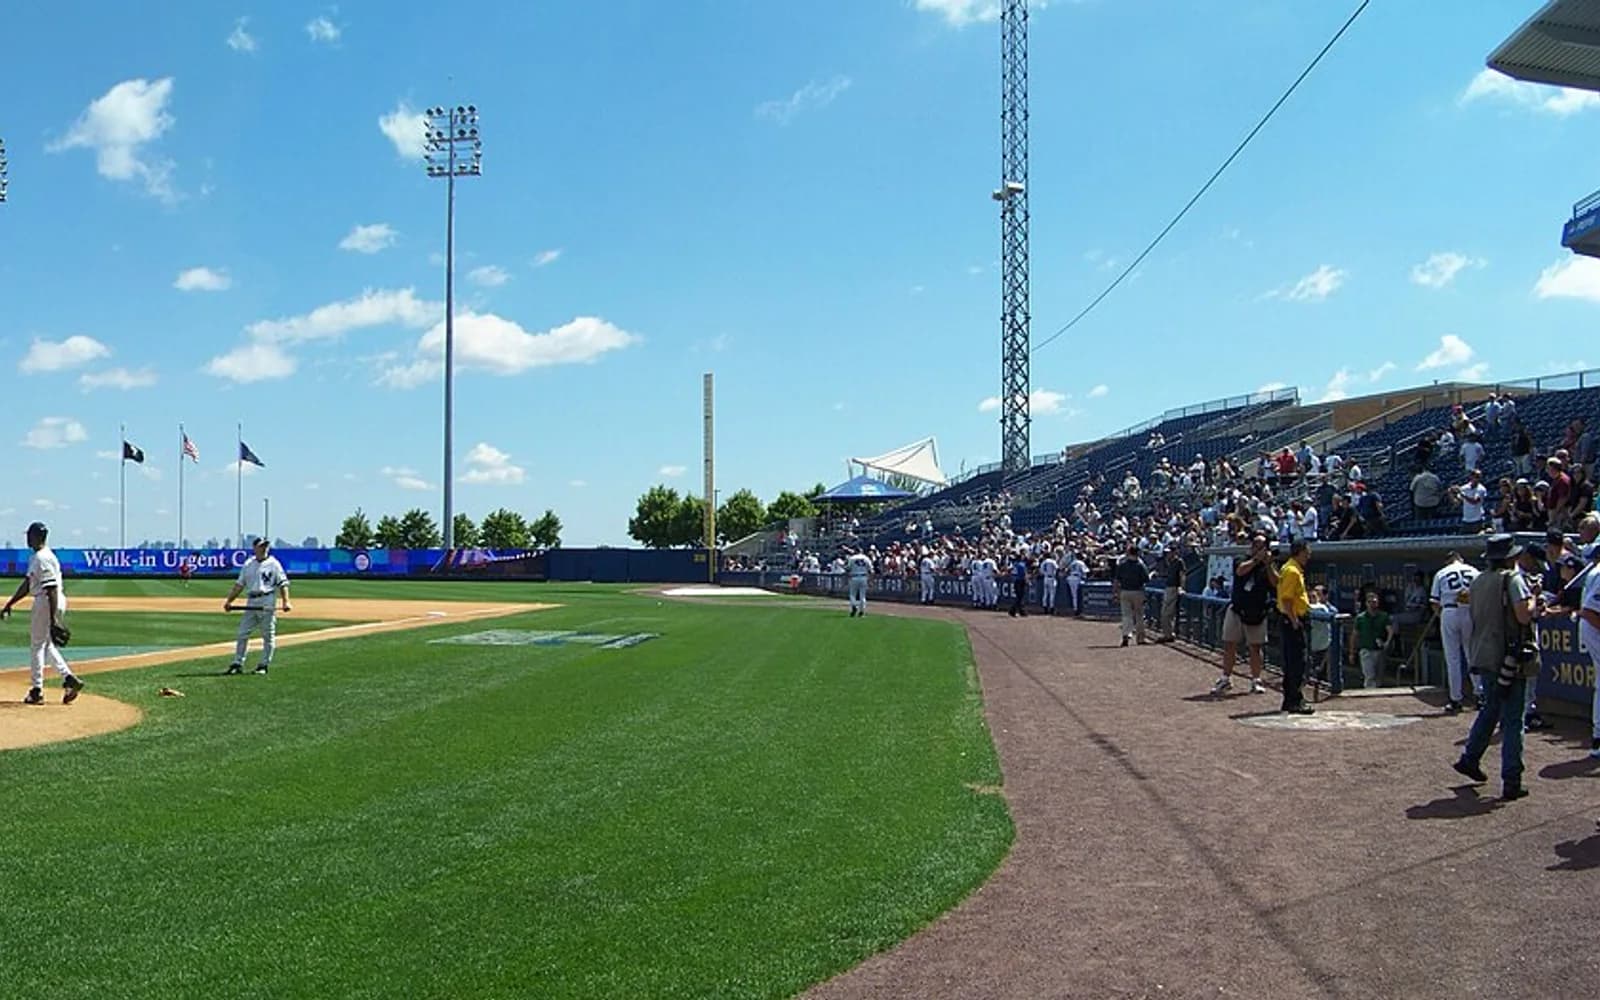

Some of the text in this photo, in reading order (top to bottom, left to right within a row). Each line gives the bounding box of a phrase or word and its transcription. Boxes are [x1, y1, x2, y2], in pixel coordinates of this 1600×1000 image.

[84, 550, 156, 567] Walk-in
[163, 550, 226, 571] Urgent
[1446, 569, 1474, 590] 25
[1540, 629, 1572, 652] ORE
